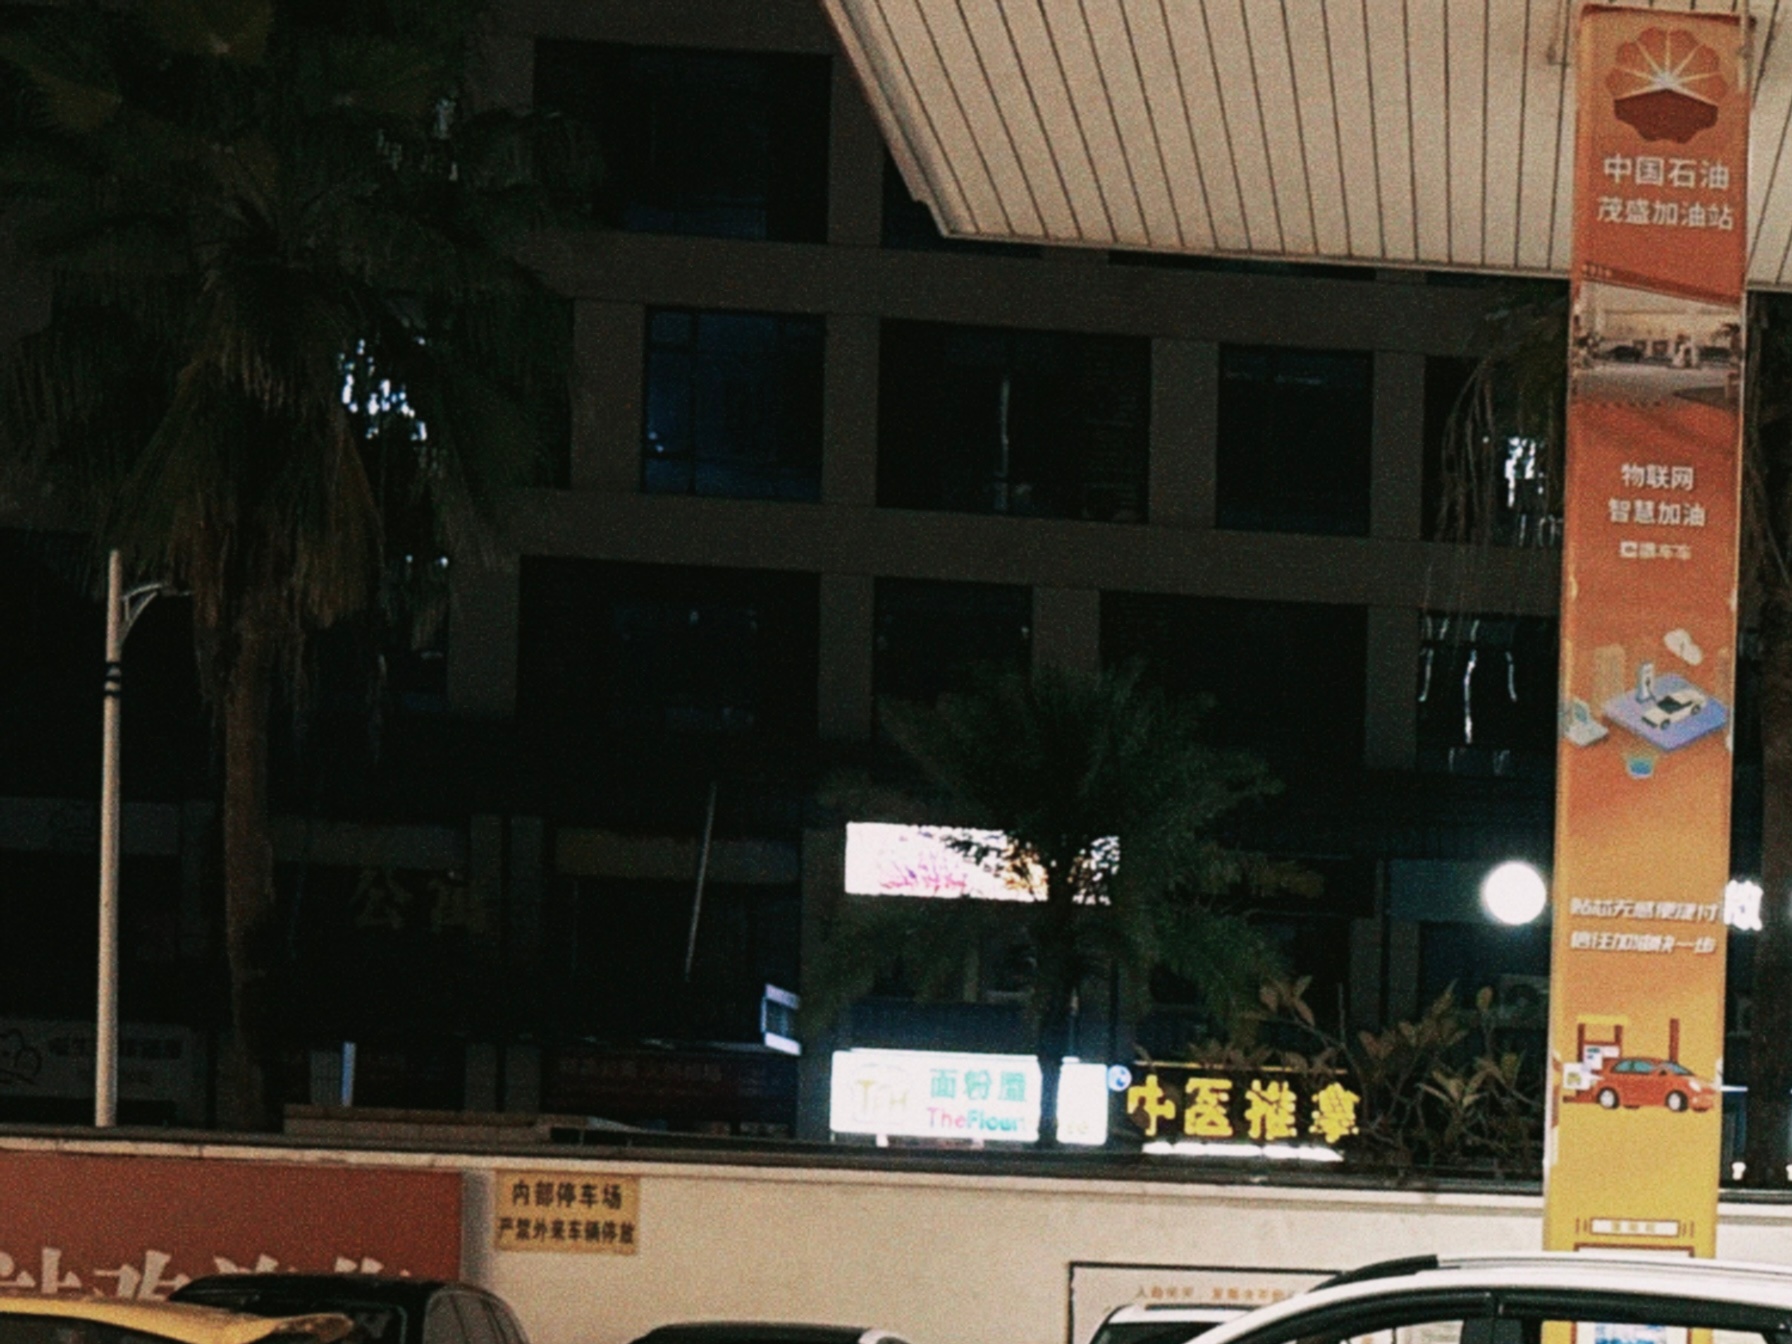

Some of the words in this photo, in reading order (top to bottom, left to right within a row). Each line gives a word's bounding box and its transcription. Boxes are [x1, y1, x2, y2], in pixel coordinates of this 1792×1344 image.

[1604, 154, 1729, 190] 中国石油
[1597, 196, 1733, 230] 茂盛加油站
[1621, 463, 1694, 491] 物联网
[1608, 498, 1706, 526] 智慧加油
[1127, 1074, 1360, 1143] 中医推拿
[511, 1179, 622, 1210] 内部停车场
